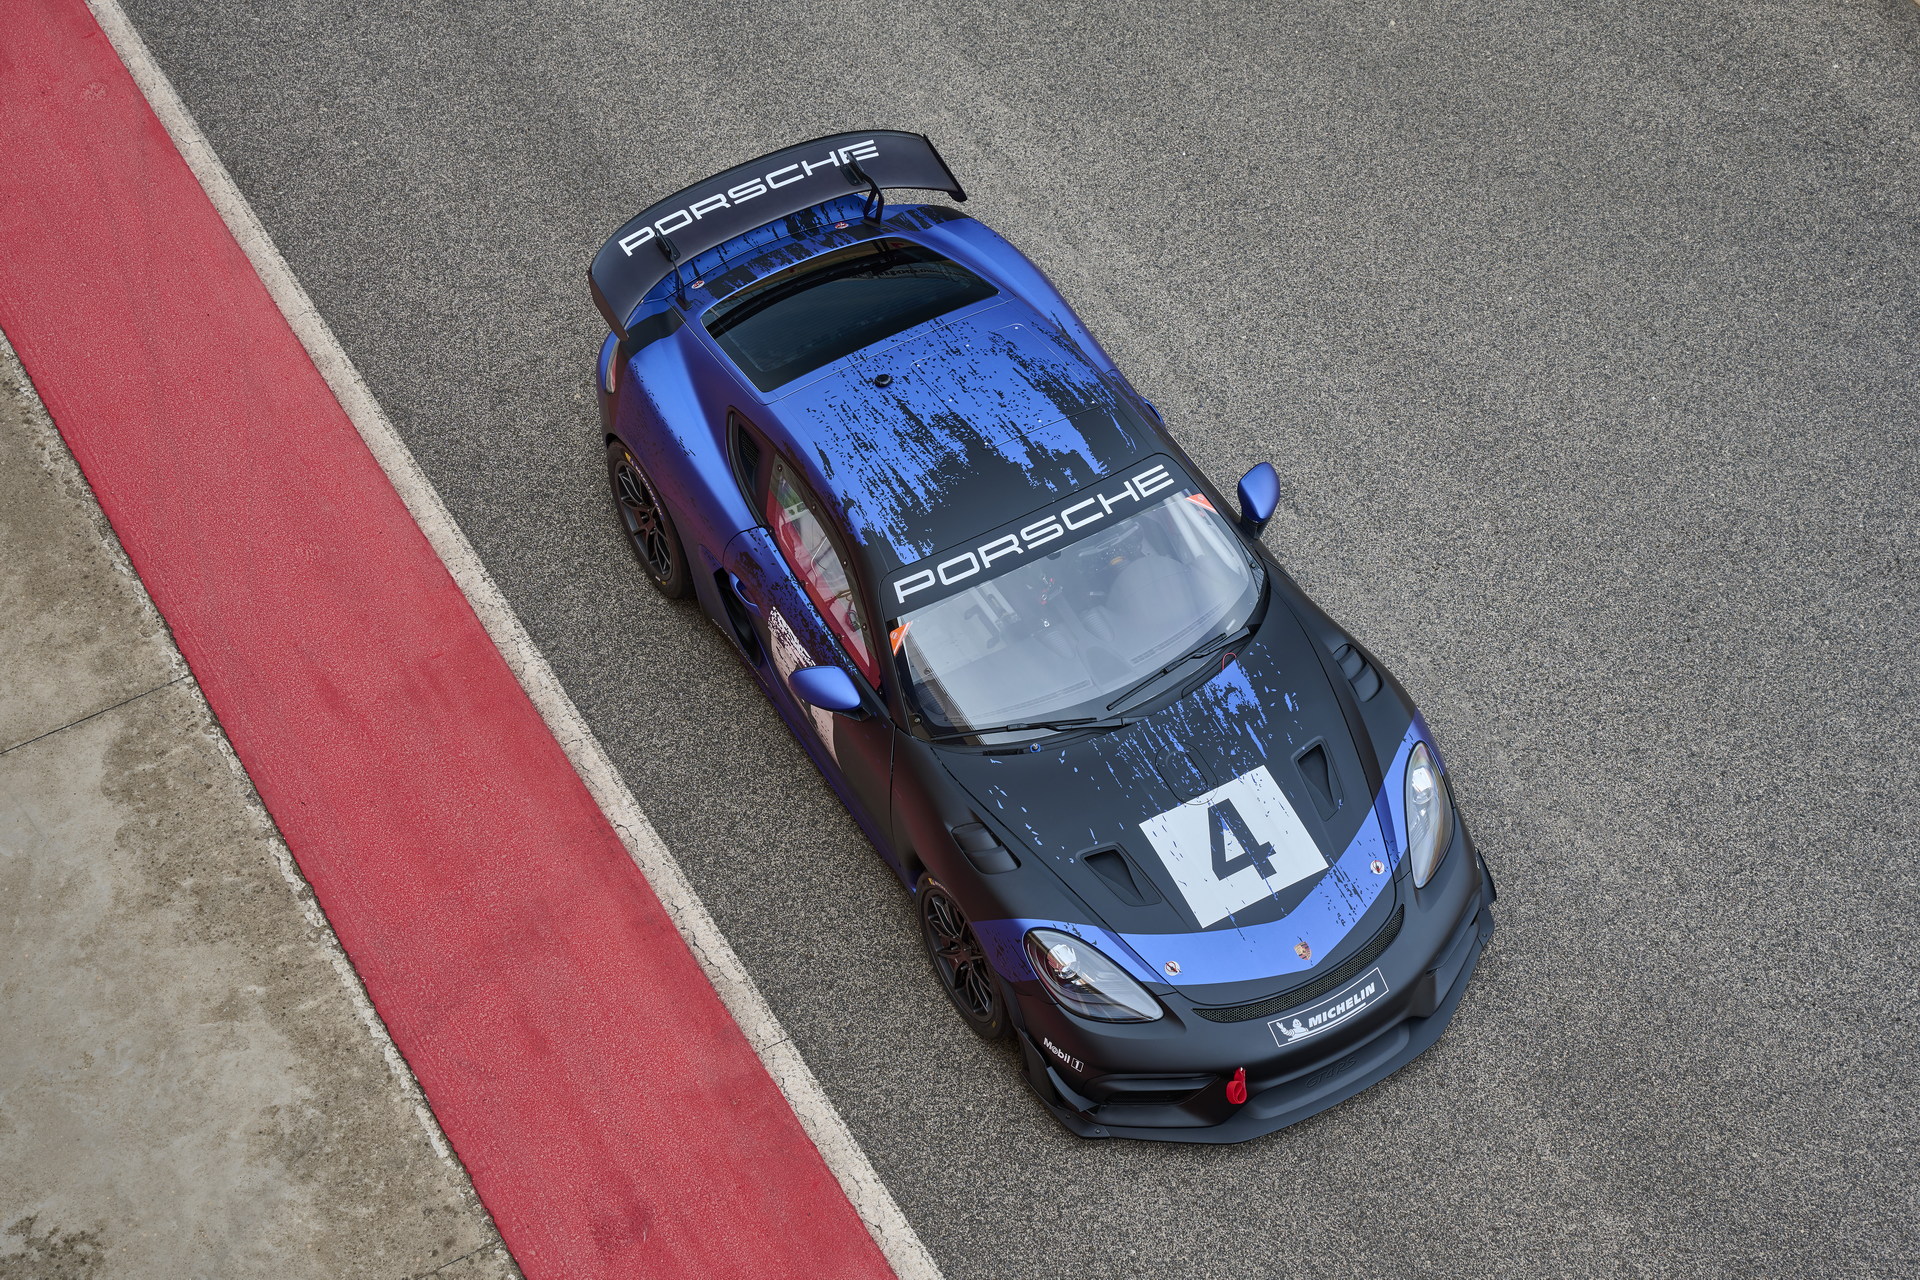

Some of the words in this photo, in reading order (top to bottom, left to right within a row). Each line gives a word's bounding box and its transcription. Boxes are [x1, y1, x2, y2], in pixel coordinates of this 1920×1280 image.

[618, 139, 880, 257] PORSCHE
[893, 464, 1175, 604] PORSCHE
[1207, 797, 1278, 882] 4
[1308, 981, 1376, 1028] MICHELIN
[1043, 1037, 1071, 1064] Mobil
